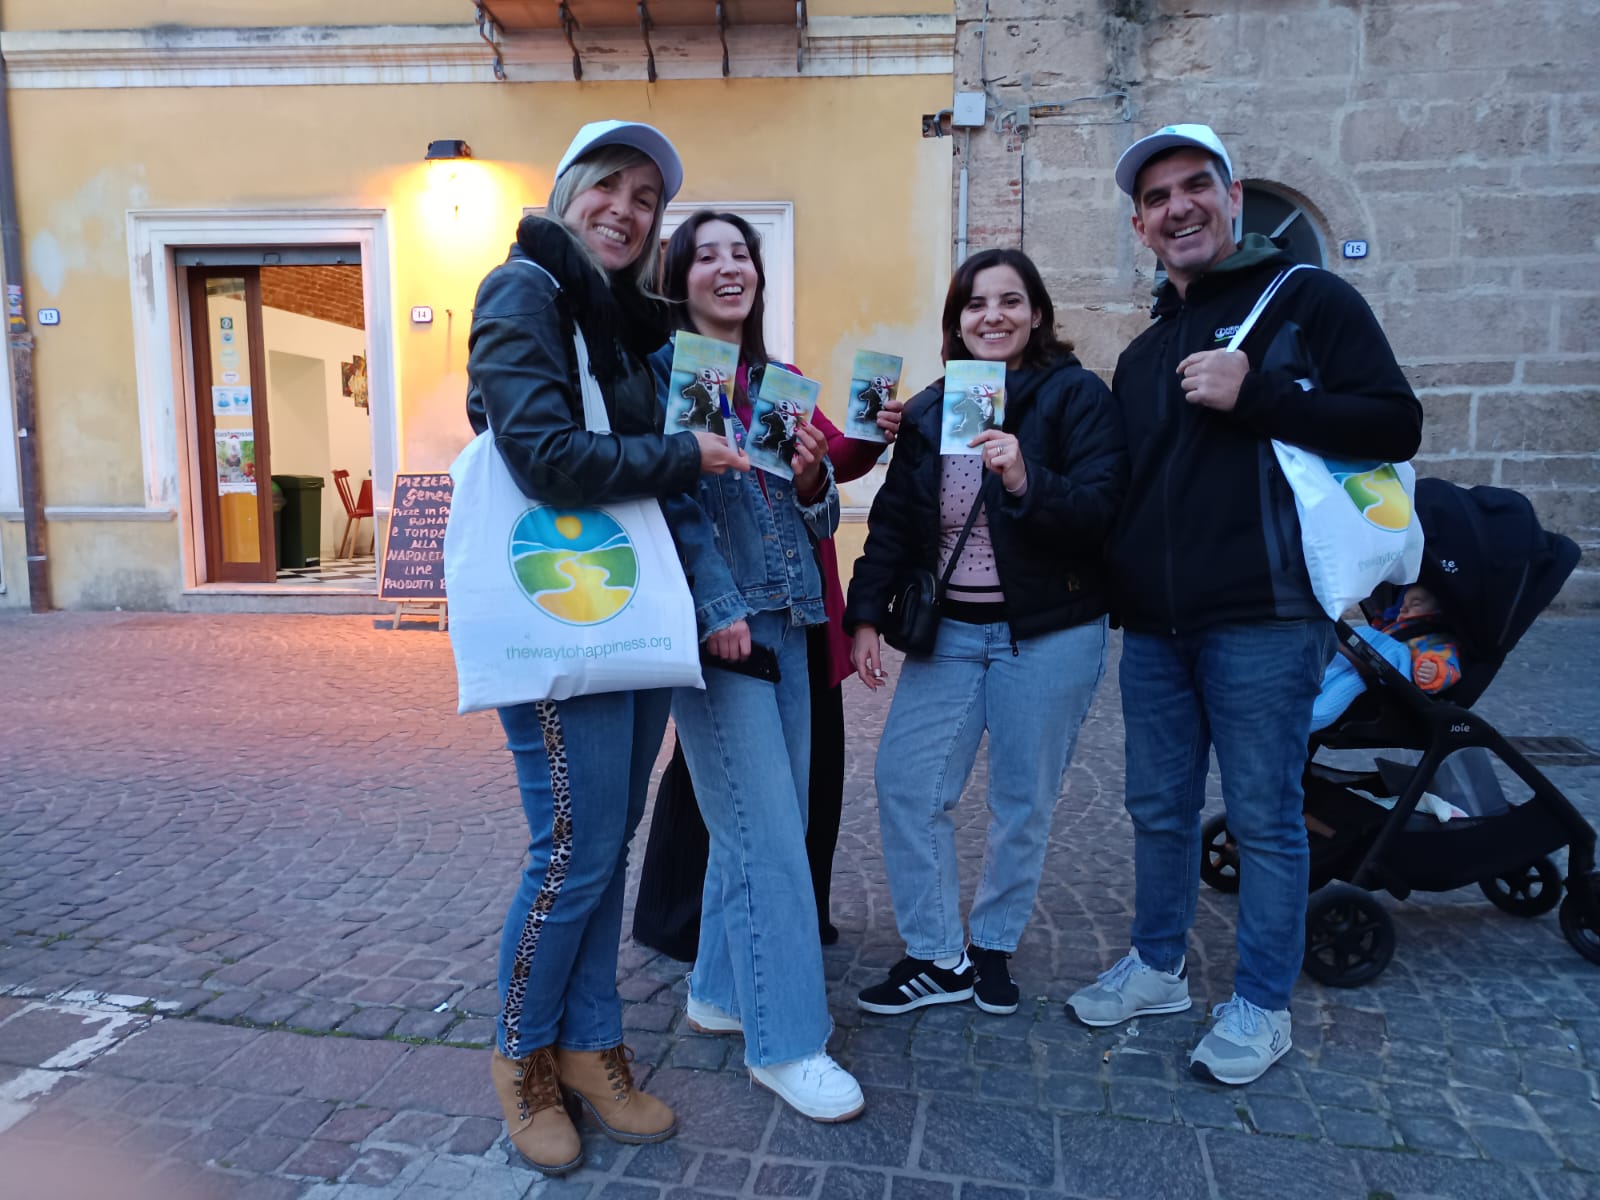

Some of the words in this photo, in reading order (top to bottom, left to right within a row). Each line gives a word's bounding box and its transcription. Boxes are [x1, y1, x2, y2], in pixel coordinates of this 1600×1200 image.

[1351, 245, 1361, 254] 15
[44, 312, 54, 321] 13
[398, 476, 451, 488] PIZZER
[411, 540, 438, 549] ALLA
[384, 577, 434, 590] PRODOTTI
[506, 636, 673, 662] thewaytohappiness.org
[1450, 722, 1470, 733] Joie
